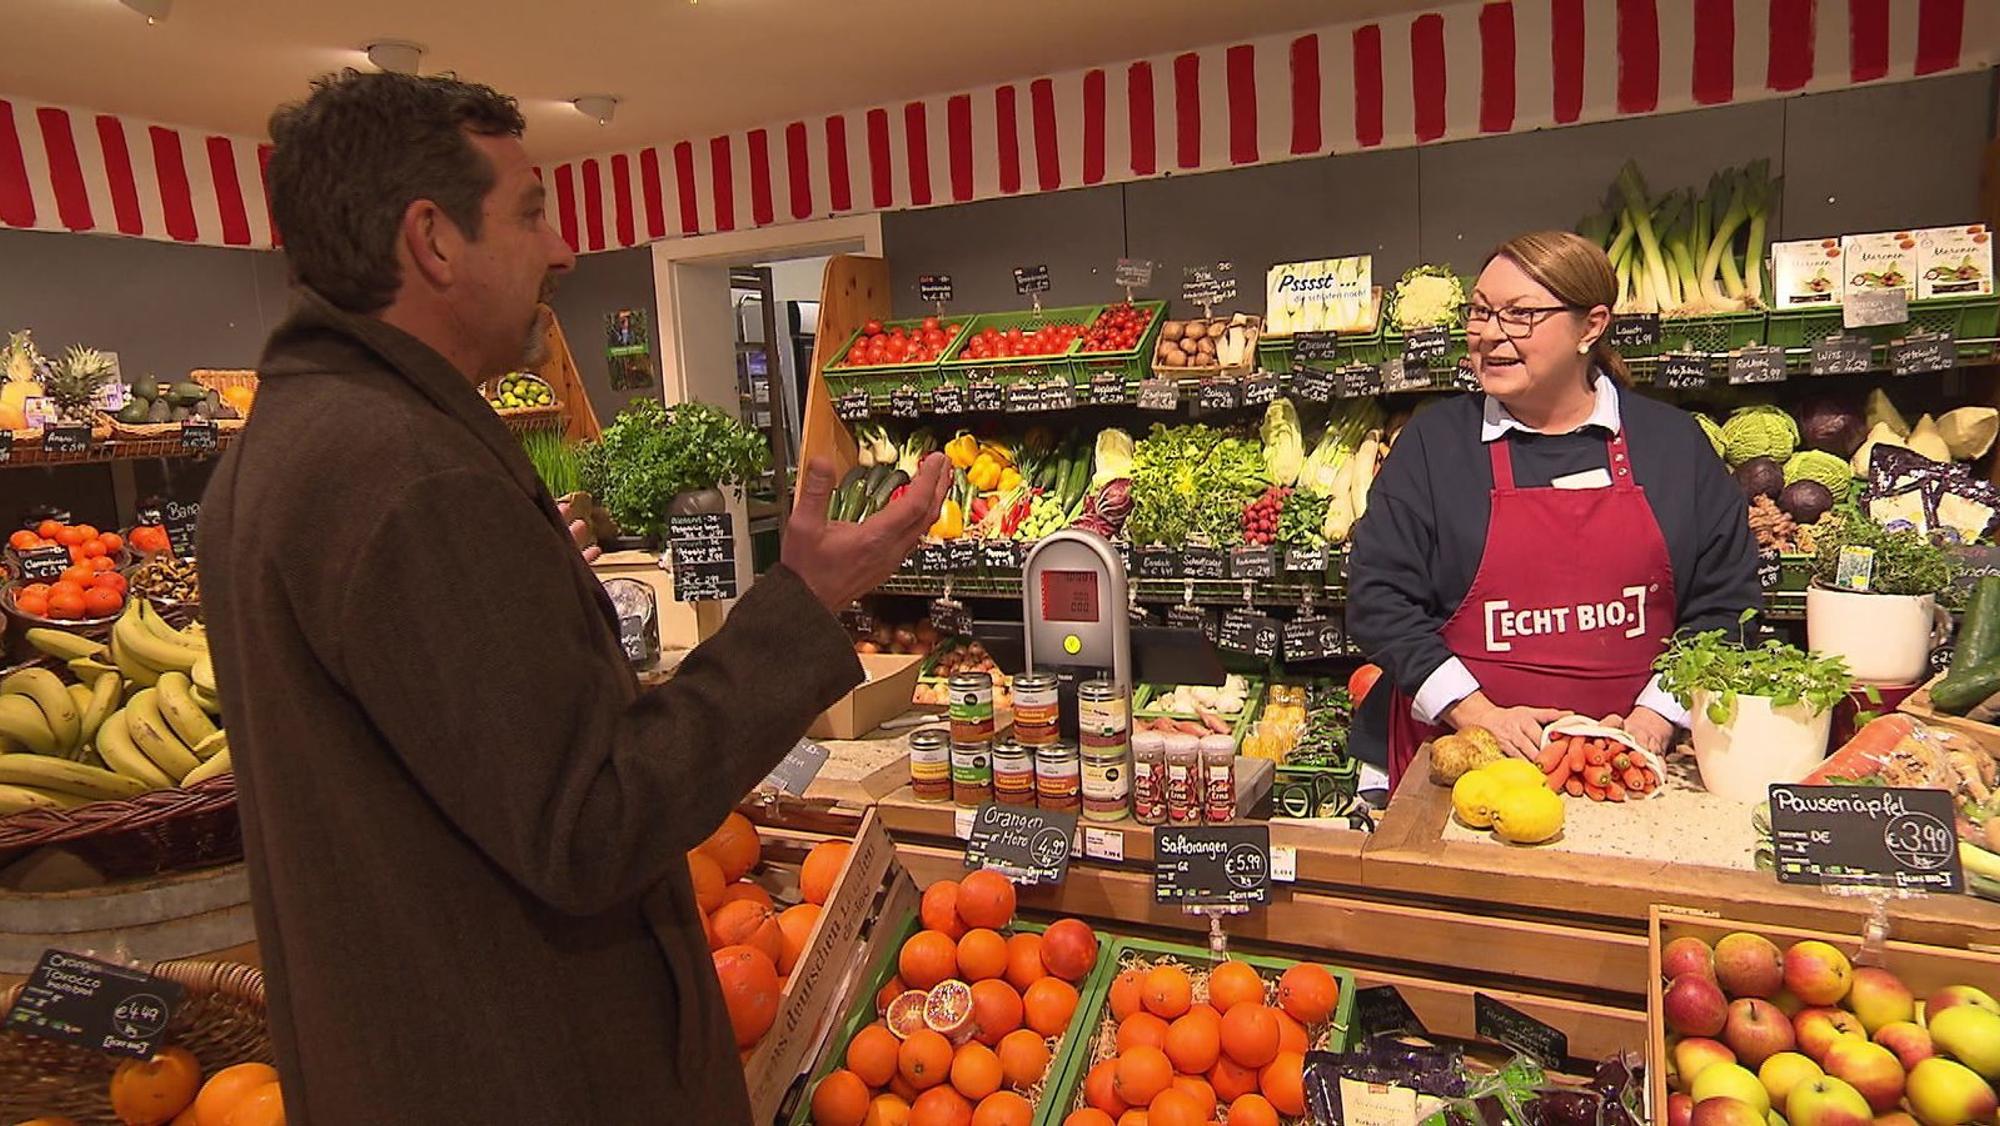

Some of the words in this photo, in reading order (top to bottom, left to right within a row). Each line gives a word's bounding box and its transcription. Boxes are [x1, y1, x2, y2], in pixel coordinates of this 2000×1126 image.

[1278, 273, 1334, 293] Psssst
[1616, 325, 1643, 335] Lauch
[1772, 789, 1907, 819] Pausenäpfel
[984, 806, 1044, 833] Orangen
[1161, 834, 1228, 860] Saftorangen
[1810, 830, 1832, 844] DE
